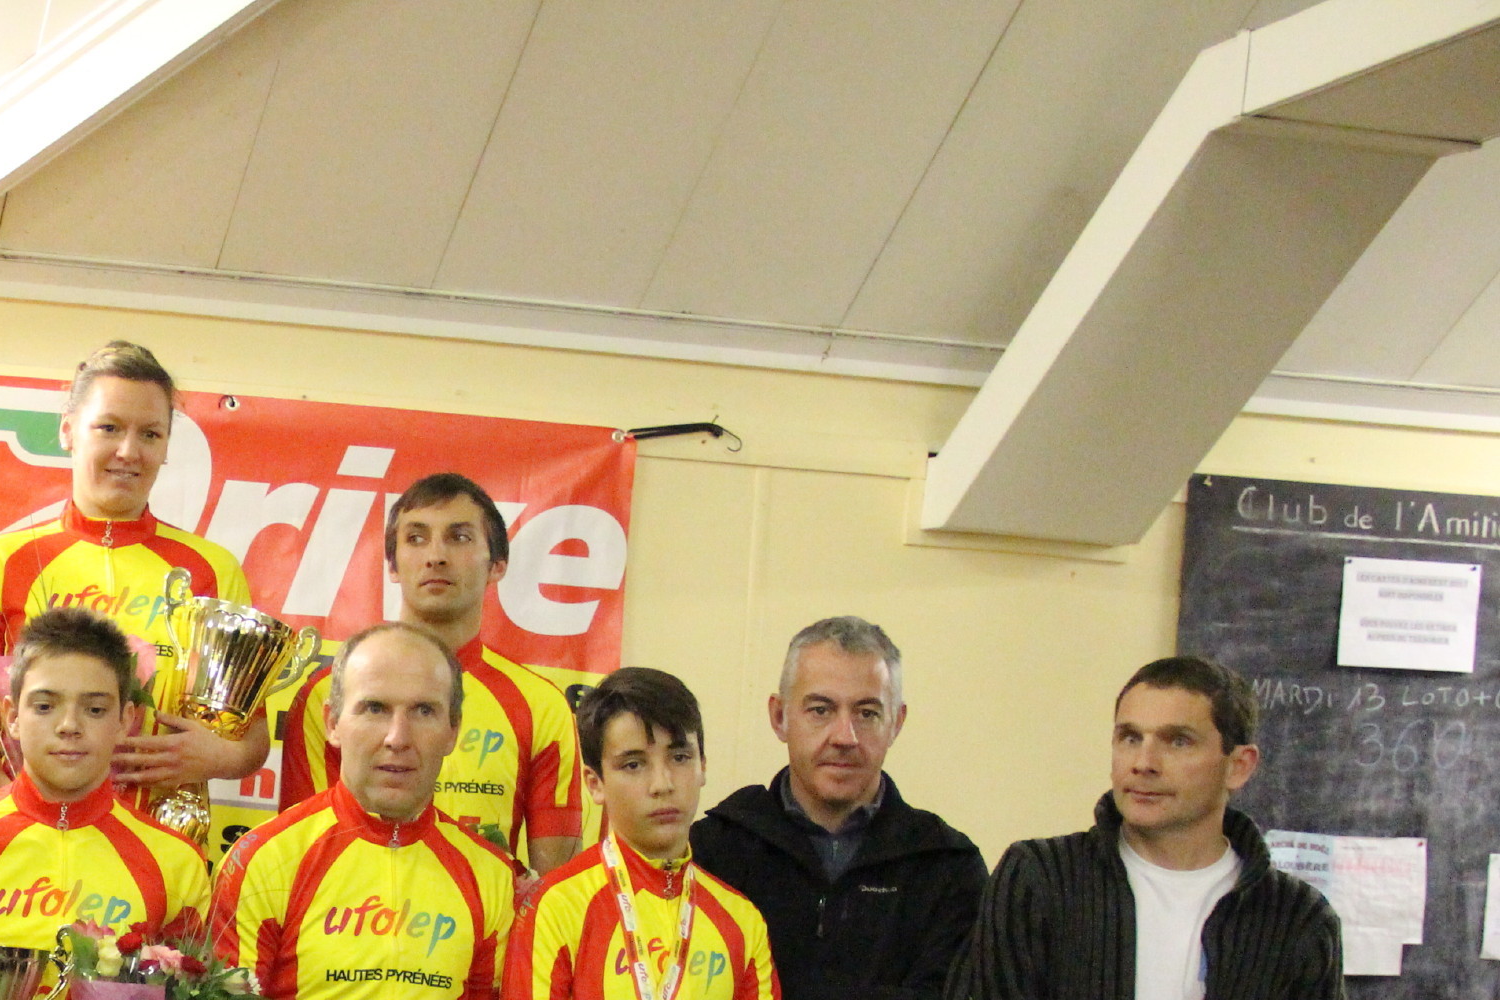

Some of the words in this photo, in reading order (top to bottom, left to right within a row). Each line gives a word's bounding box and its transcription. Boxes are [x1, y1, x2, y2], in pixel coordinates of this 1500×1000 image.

[1237, 486, 1328, 525] Club
[1344, 506, 1373, 530] de
[444, 778, 505, 796] PYRÉNÉES
[324, 895, 456, 959] ufolep
[325, 969, 383, 983] HAUTES
[385, 968, 453, 990] PYRÉNÉES
[615, 937, 727, 995] ufoep
